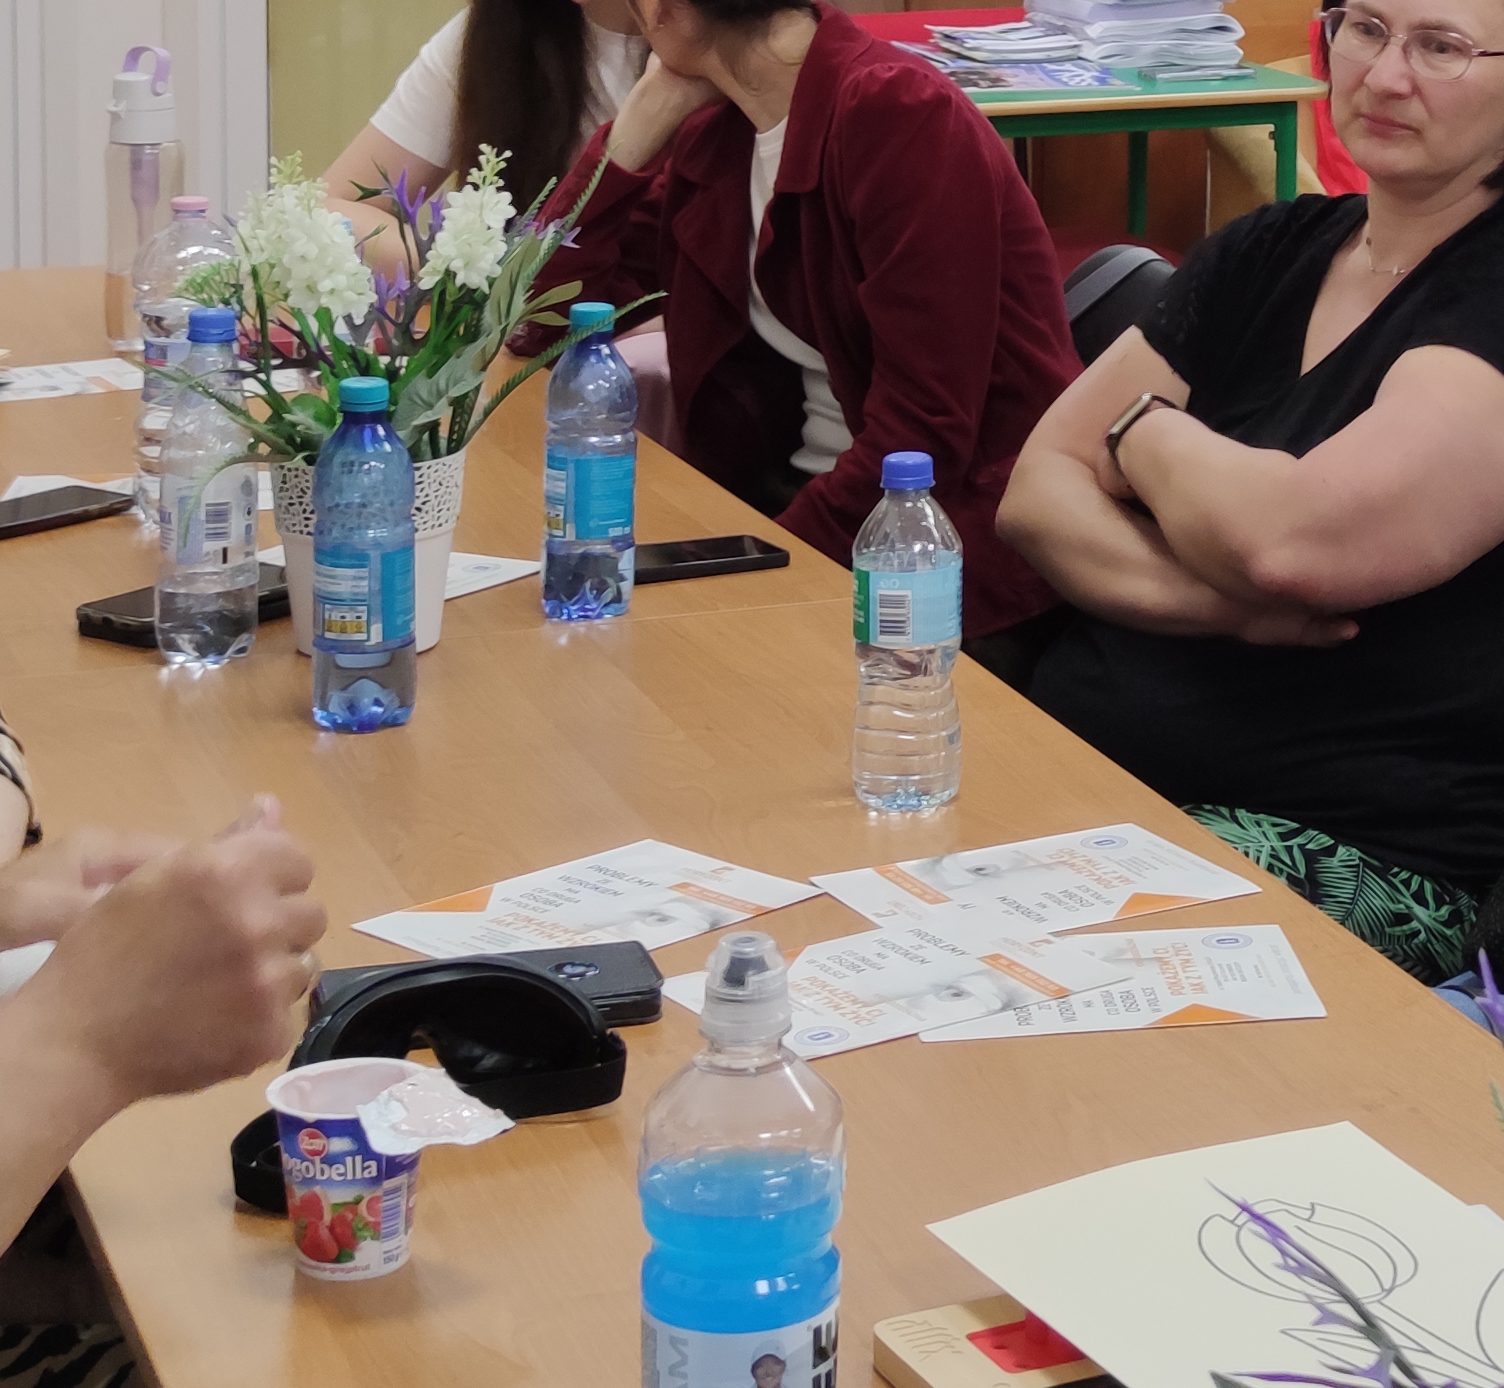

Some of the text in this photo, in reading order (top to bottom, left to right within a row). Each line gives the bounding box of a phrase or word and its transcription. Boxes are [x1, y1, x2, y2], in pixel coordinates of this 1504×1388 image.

[557, 874, 625, 897] WZROKIEM
[586, 864, 659, 887] PROBLEMY
[519, 892, 564, 908] OSOBA
[872, 937, 932, 966] WZROKIEM
[905, 928, 971, 957] PROBLEMY
[826, 955, 867, 974] OSOBA
[1118, 989, 1142, 1013] OSOBA
[1013, 1008, 1035, 1027] PROB
[283, 1155, 378, 1182] gobella
